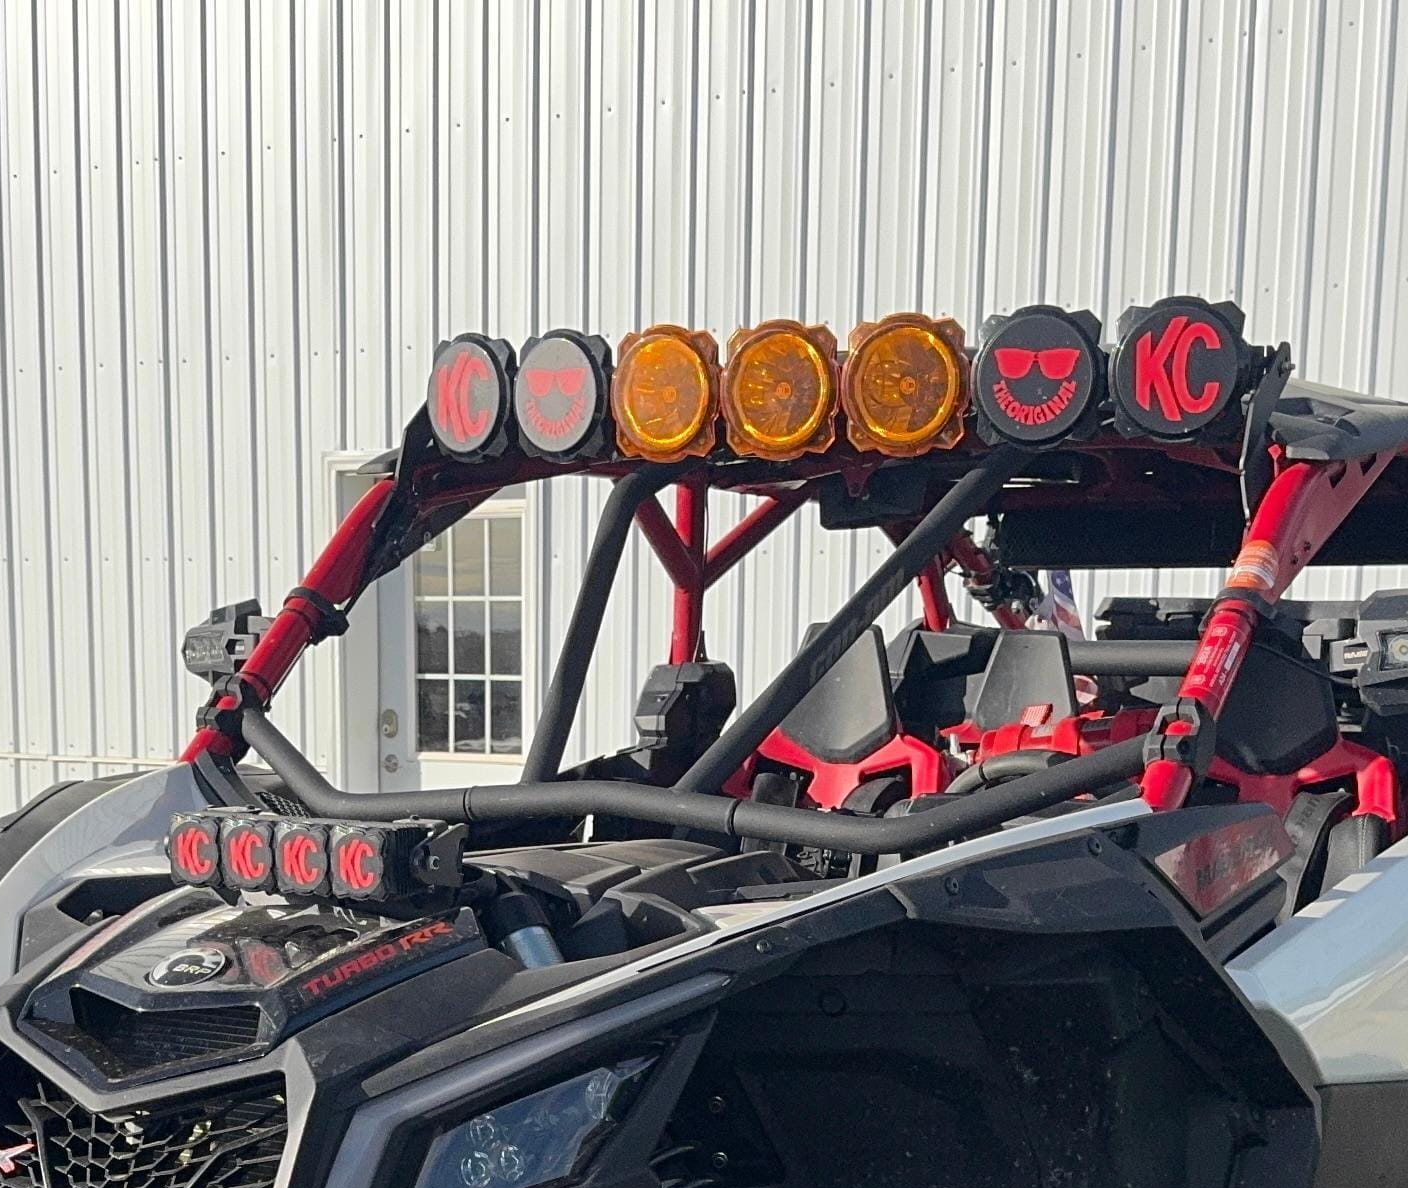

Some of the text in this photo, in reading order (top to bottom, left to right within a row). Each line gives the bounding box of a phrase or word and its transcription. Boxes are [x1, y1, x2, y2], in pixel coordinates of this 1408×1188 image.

[1135, 315, 1221, 421] KC
[437, 352, 489, 443] KC
[1006, 380, 1077, 426] ORIGINAL
[177, 827, 211, 876] KC
[229, 830, 264, 880] KC
[283, 835, 319, 885] KC
[339, 839, 374, 890] KC
[172, 963, 213, 976] BRP
[302, 919, 455, 996] TURBO RR
